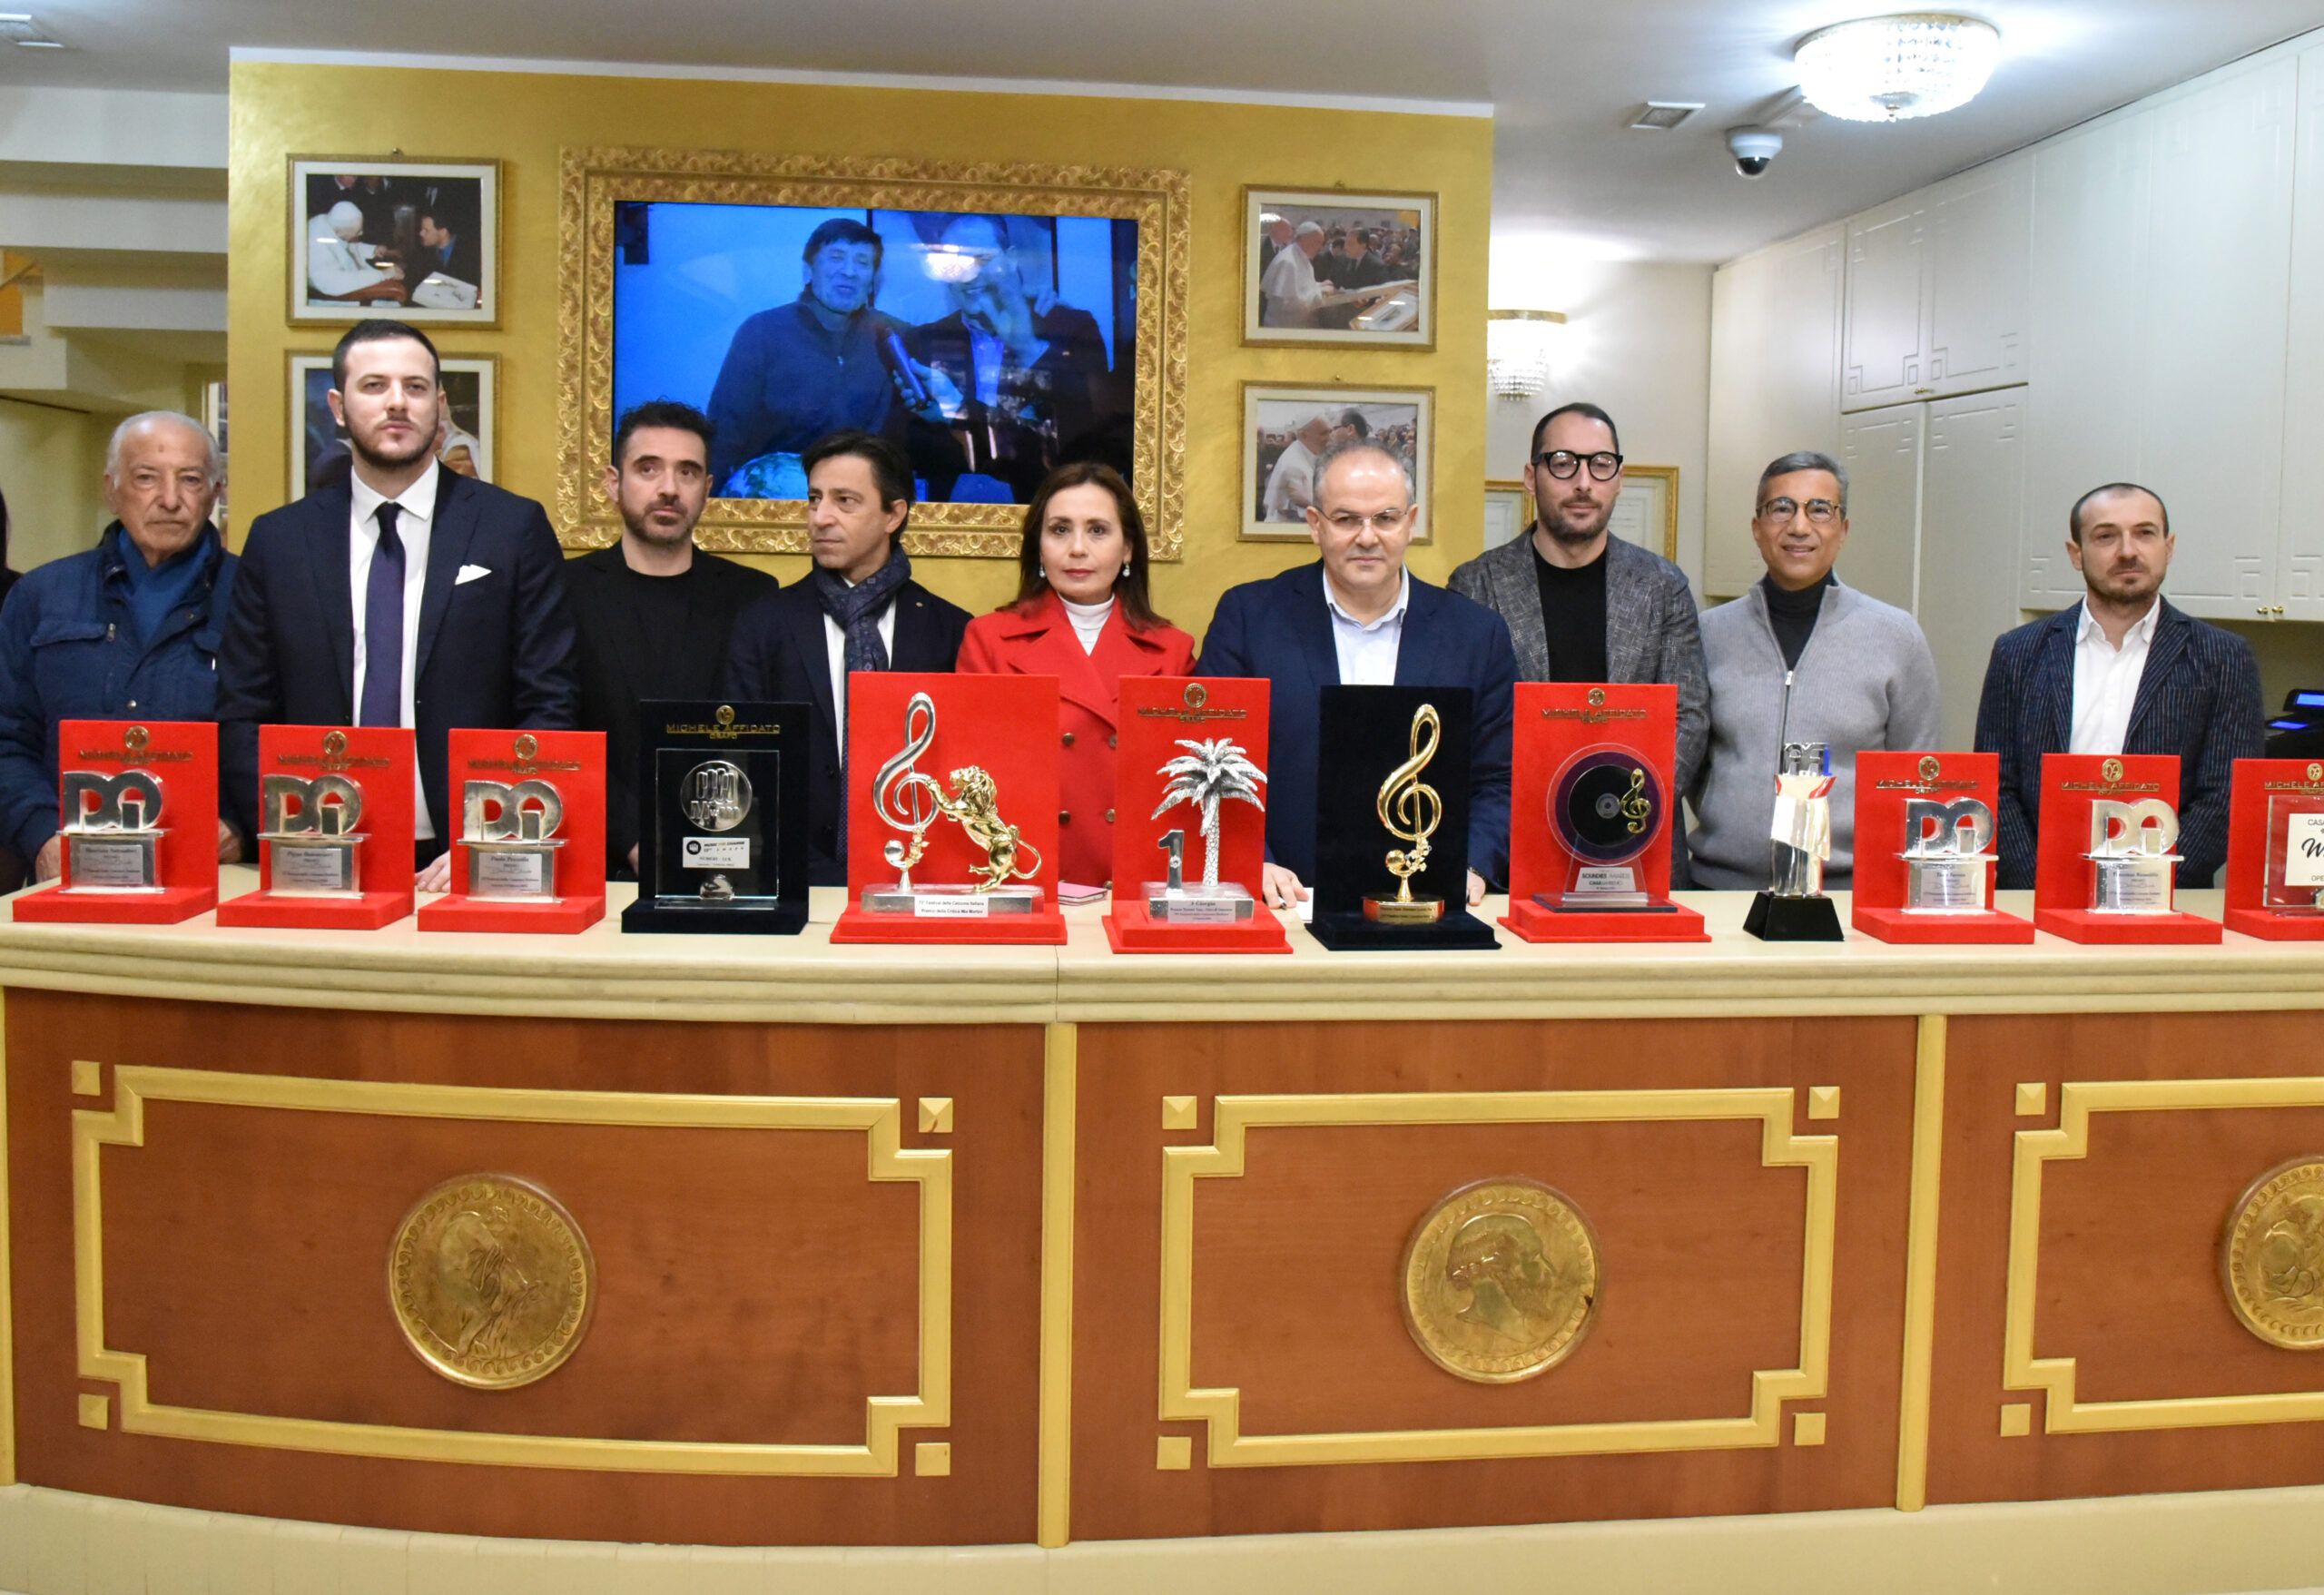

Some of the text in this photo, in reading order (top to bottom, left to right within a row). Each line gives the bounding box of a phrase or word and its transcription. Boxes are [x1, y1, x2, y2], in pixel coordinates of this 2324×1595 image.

[666, 723, 781, 734] MICHELE AFFIDATO
[2062, 782, 2160, 792] MICHELE AFFIDATO
[2265, 781, 2310, 789] MICHELE
